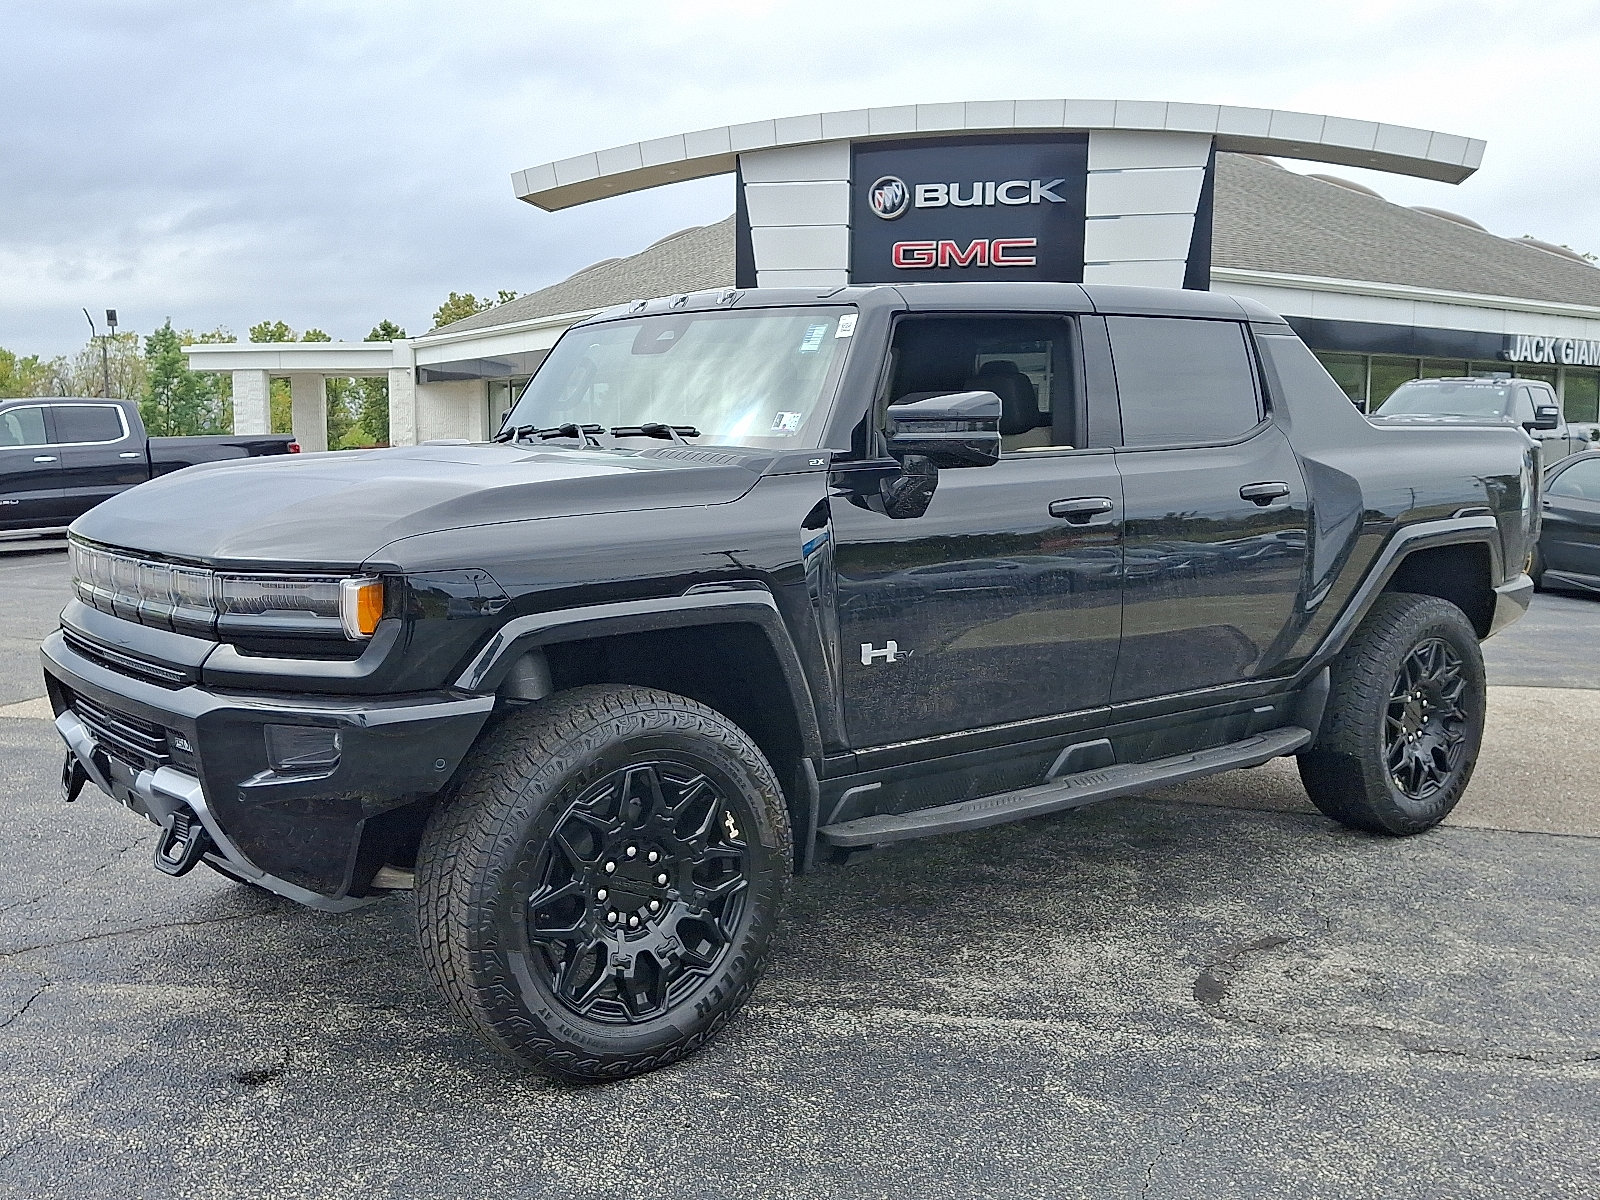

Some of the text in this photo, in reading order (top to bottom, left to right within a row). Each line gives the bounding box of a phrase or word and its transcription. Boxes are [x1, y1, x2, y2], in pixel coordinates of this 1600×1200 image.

[915, 179, 1066, 208] BUICK
[892, 238, 1037, 268] GMC
[1510, 336, 1556, 363] JACK
